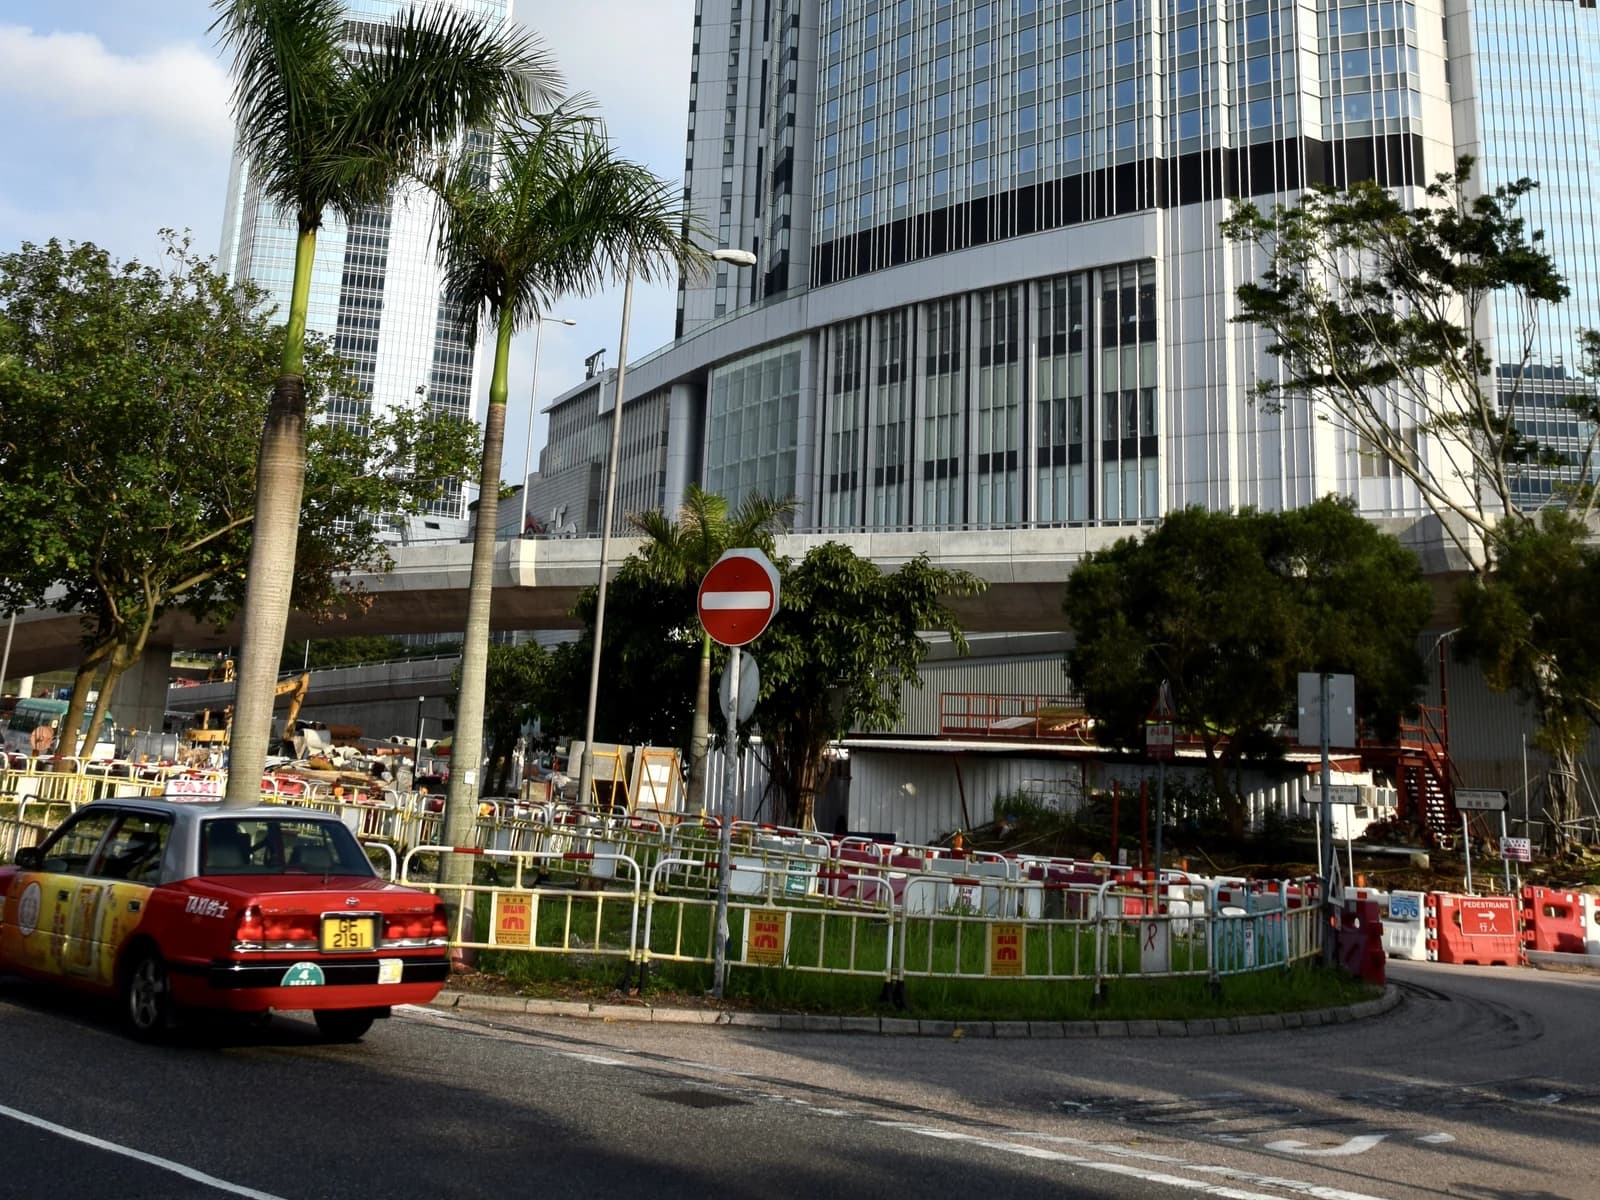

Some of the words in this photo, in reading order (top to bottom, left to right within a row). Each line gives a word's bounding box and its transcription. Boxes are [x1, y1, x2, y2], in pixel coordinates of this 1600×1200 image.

[174, 781, 218, 793] TAXI
[1463, 901, 1509, 909] PEDESTRIANS
[339, 919, 358, 933] GF
[1479, 922, 1498, 933] 行人
[333, 933, 364, 948] 2191
[298, 969, 310, 980] 4
